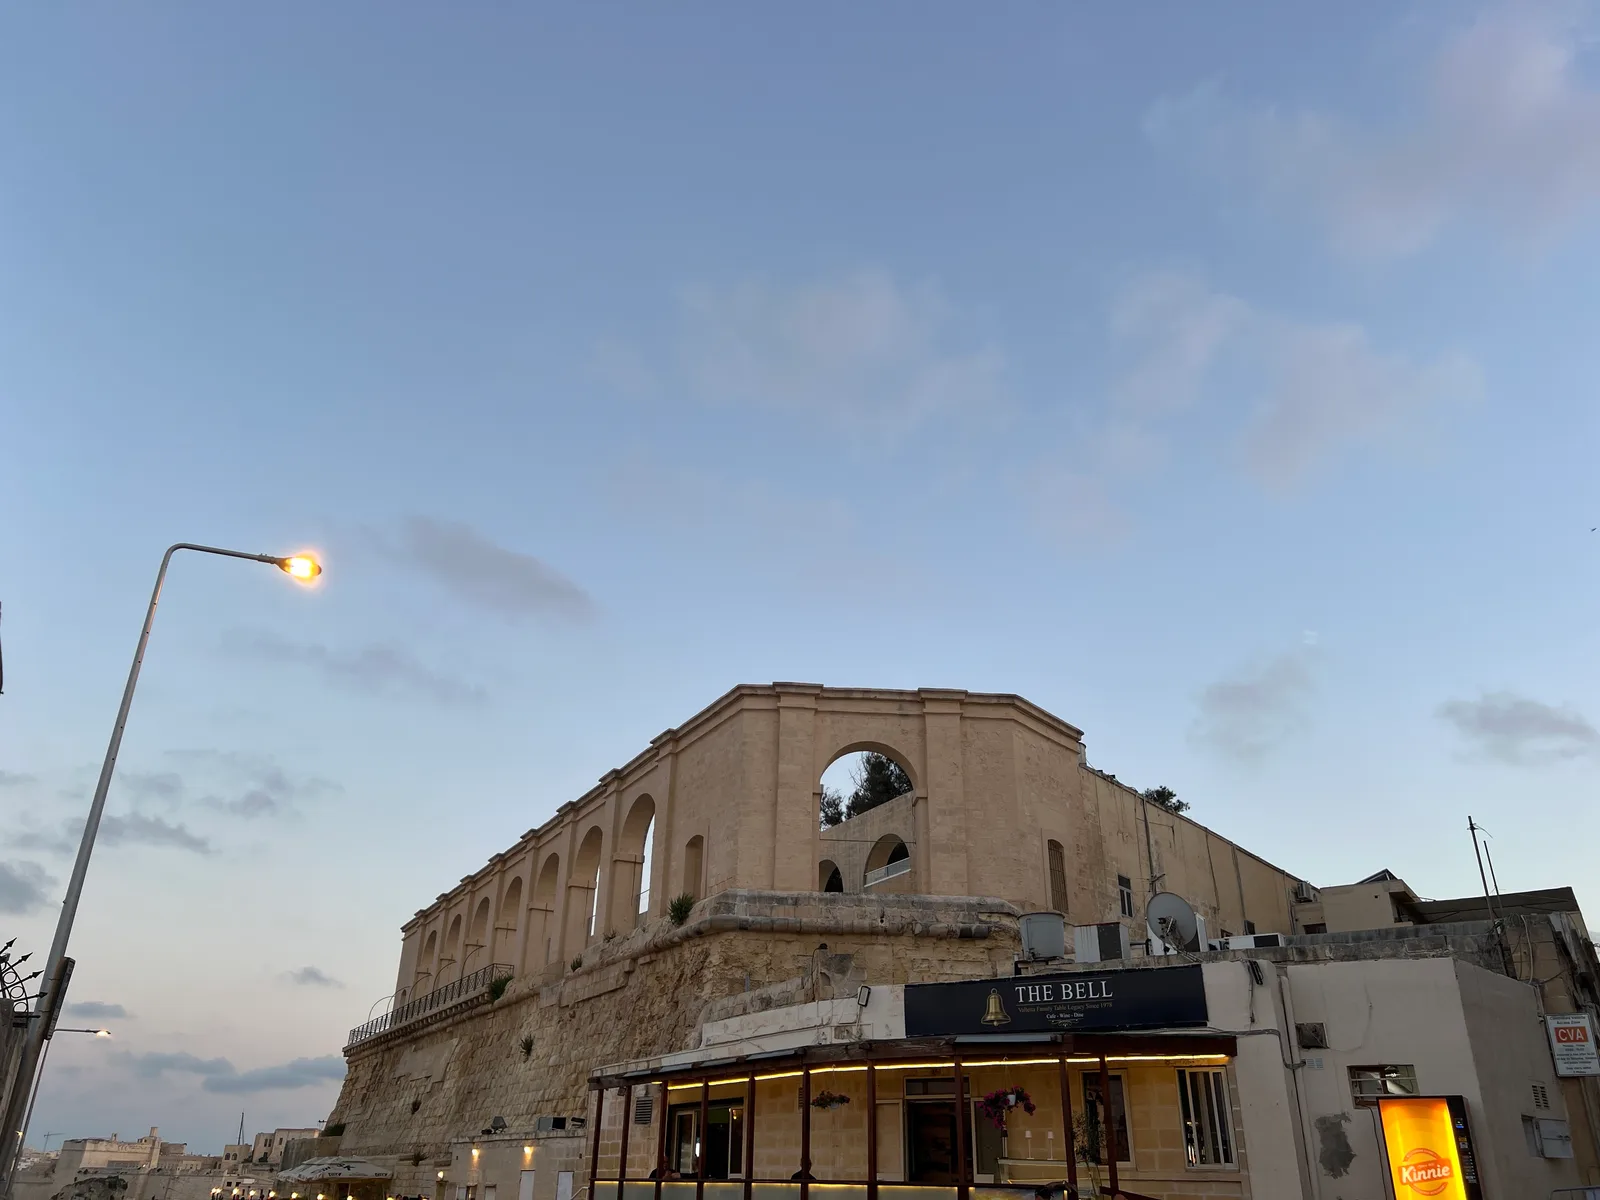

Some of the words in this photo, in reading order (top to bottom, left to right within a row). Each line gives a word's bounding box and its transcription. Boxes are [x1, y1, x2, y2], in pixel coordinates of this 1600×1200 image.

[1015, 984, 1054, 1002] THE
[1061, 981, 1113, 1000] BELL
[1558, 1028, 1585, 1041] CVA
[1401, 1164, 1450, 1184] Kinnie
